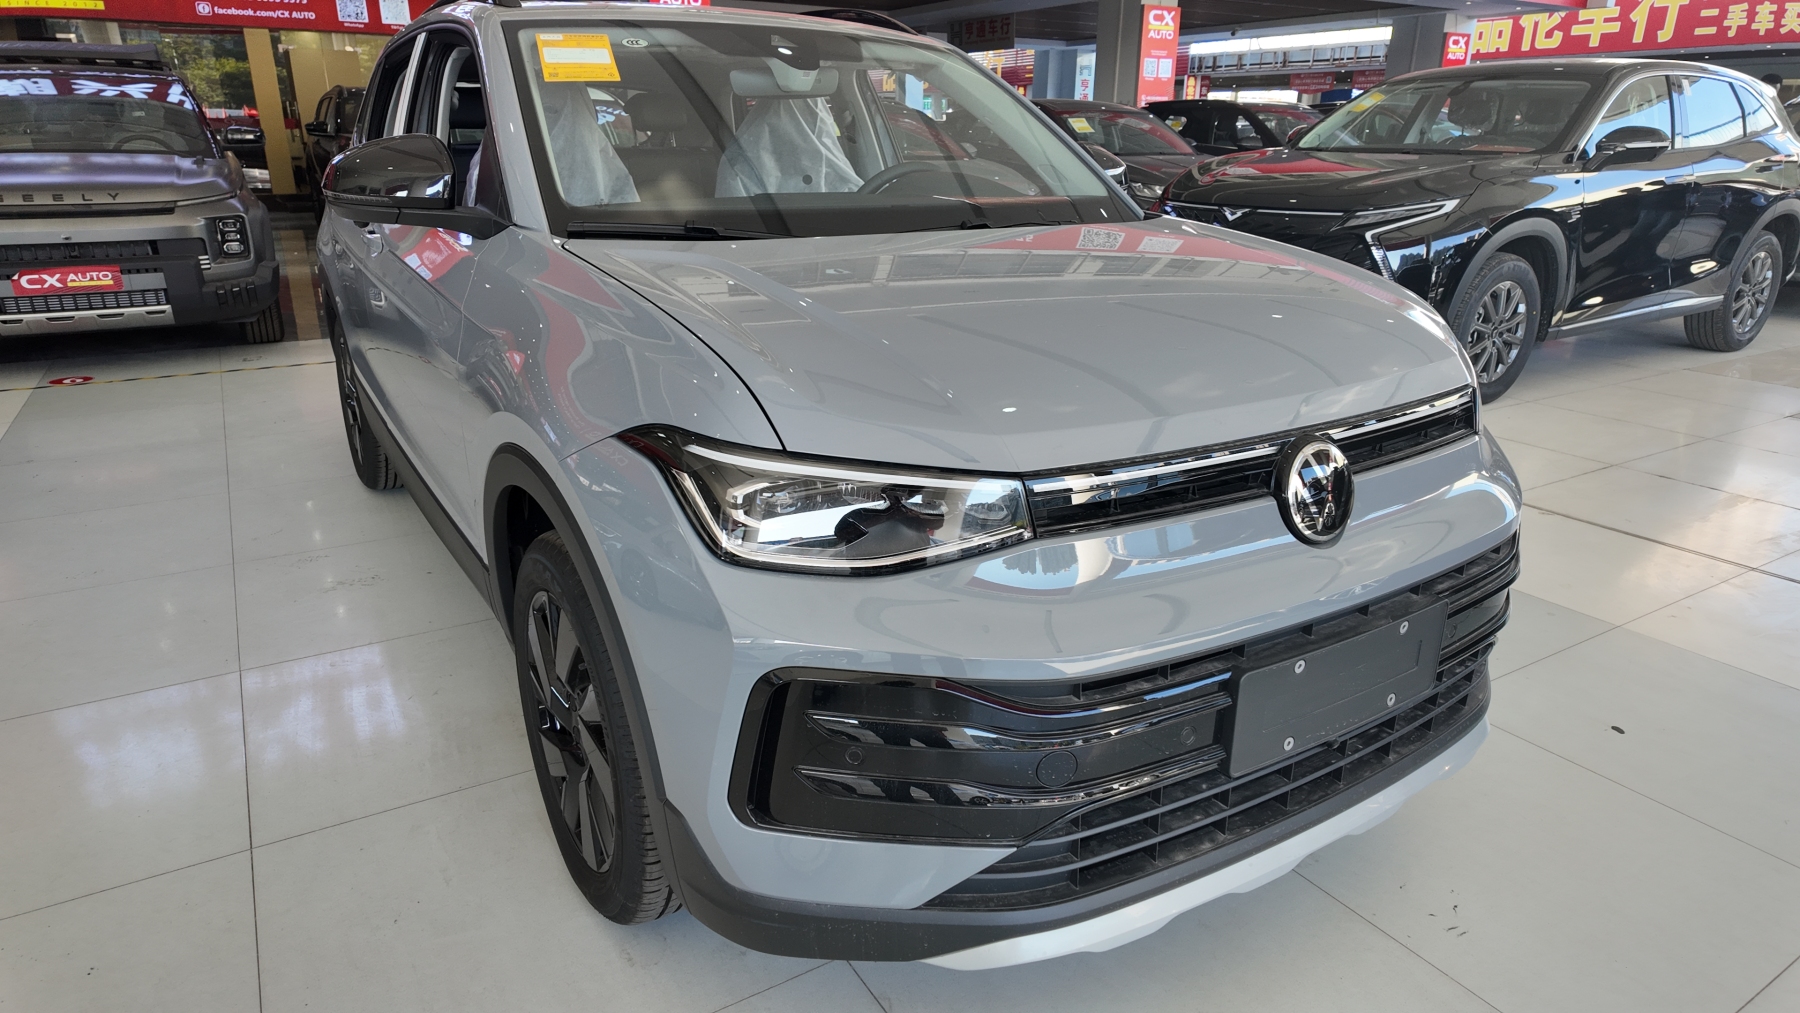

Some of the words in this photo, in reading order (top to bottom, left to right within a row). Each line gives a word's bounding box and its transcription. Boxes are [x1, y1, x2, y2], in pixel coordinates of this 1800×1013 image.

[213, 6, 290, 18] facebook.com/CX
[291, 11, 316, 20] AUTO
[1148, 9, 1176, 26] CX
[964, 16, 1011, 40] 亨通车行
[1147, 29, 1175, 40] AUTO
[1448, 35, 1468, 50] CX
[1446, 52, 1466, 61] AUTO
[19, 273, 64, 290] CX
[66, 271, 113, 282] AUTO
